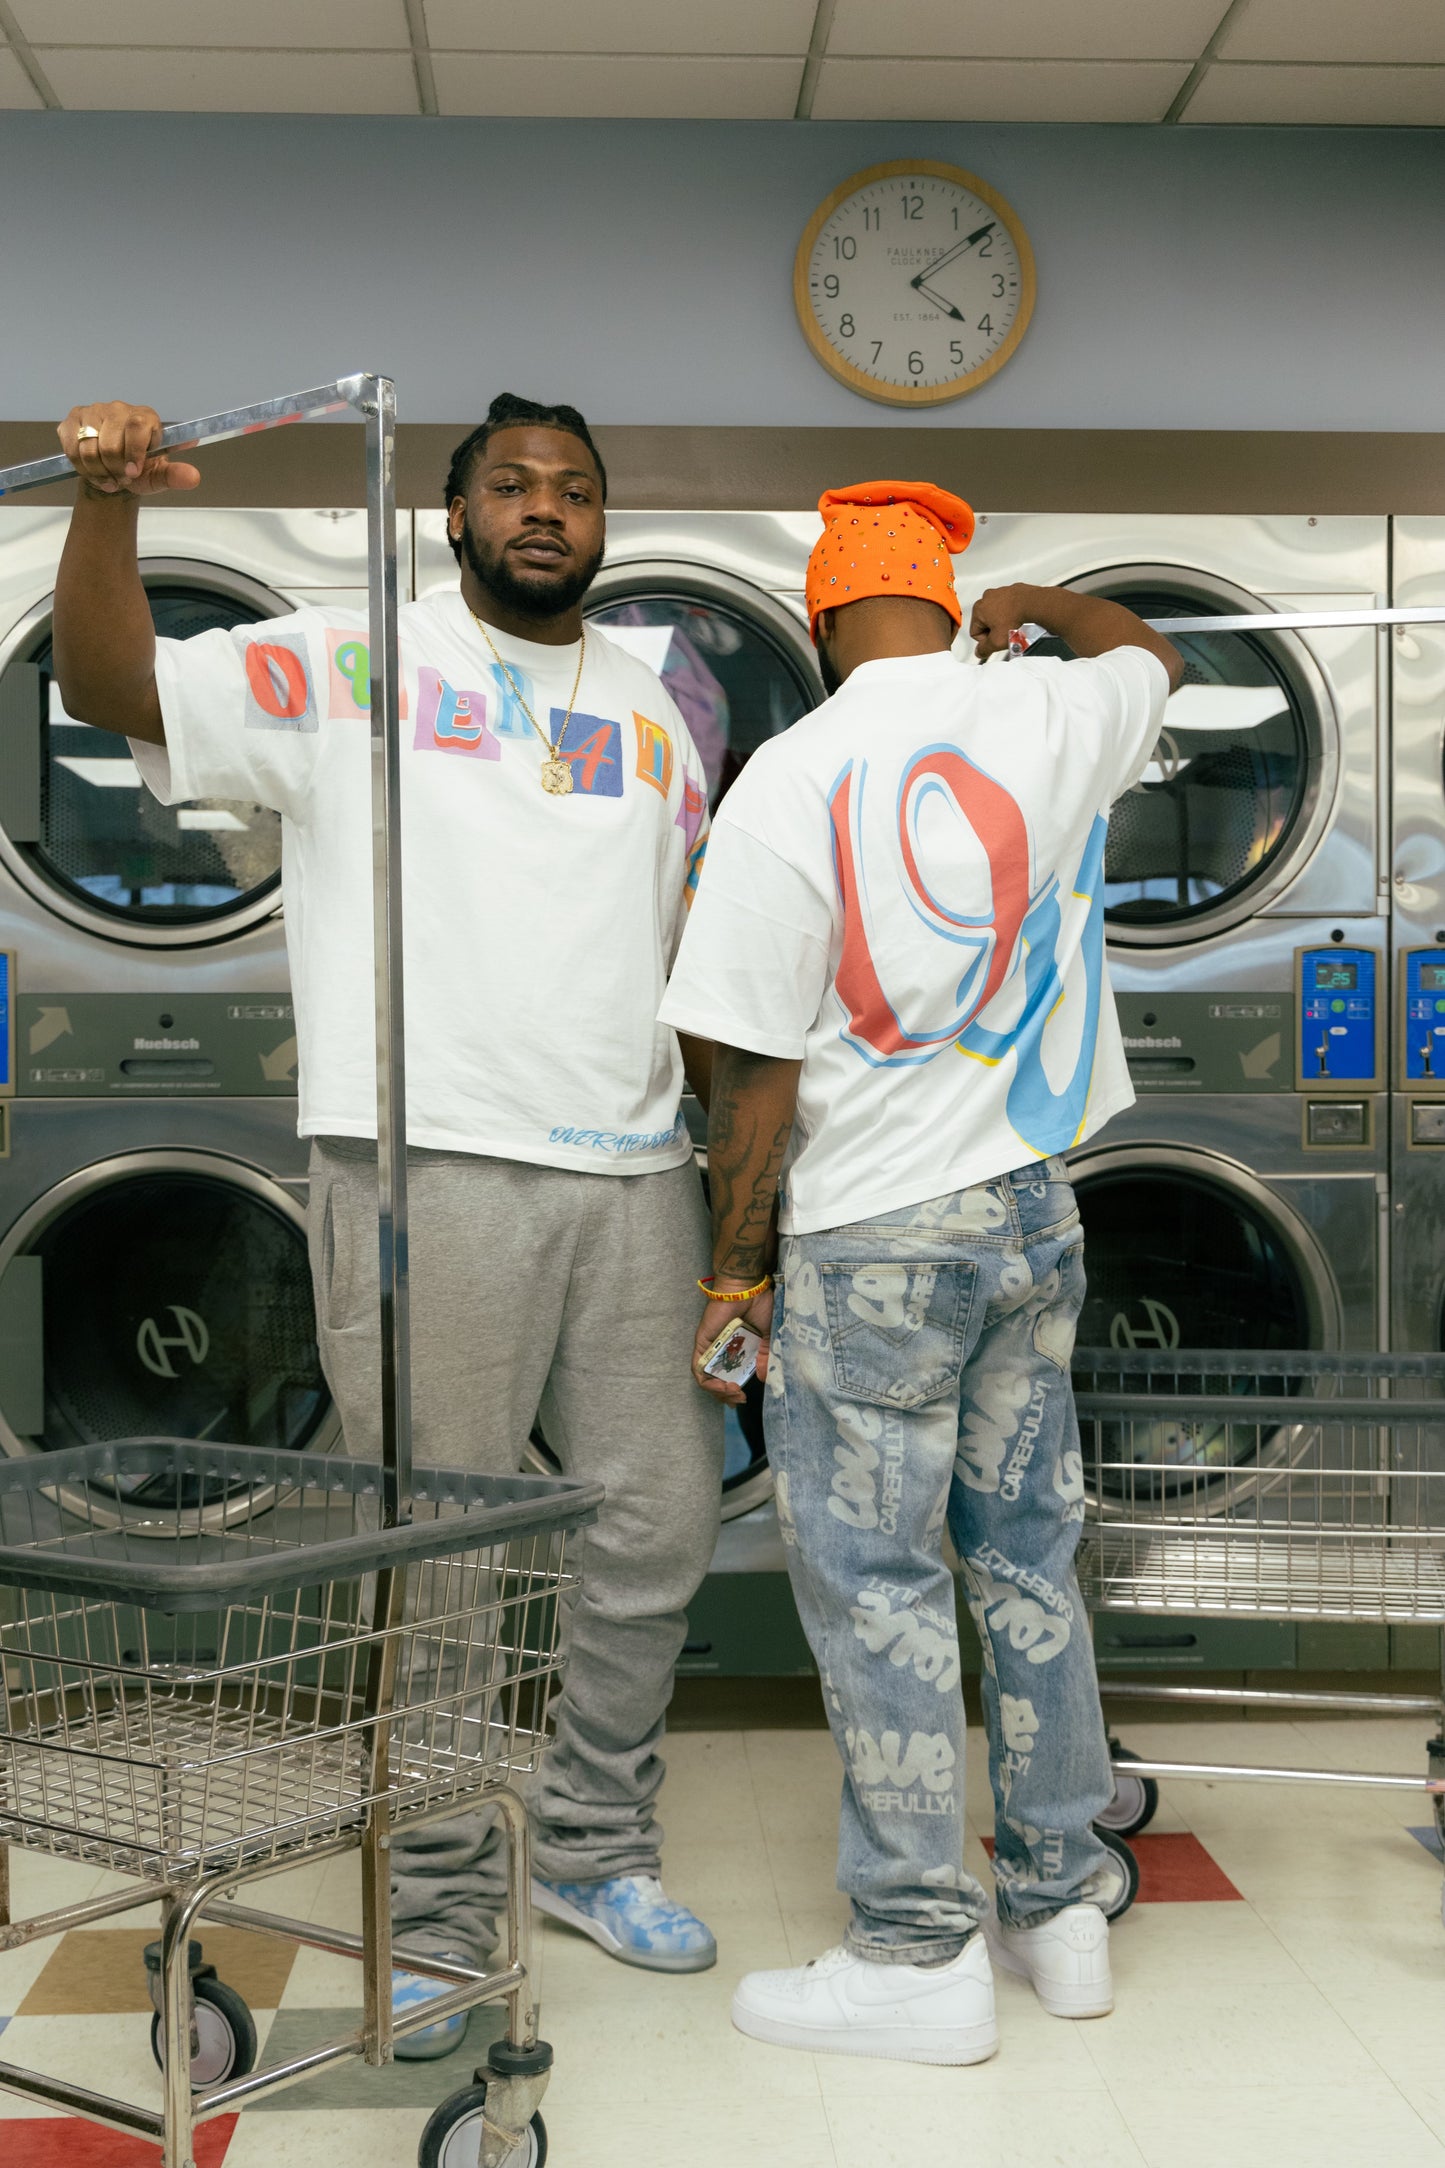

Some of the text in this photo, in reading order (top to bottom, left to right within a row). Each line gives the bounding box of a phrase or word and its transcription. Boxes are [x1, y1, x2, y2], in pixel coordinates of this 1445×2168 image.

[863, 207, 880, 231] 11
[901, 195, 925, 220] 12
[951, 207, 958, 231] 1
[833, 236, 857, 260] 10
[886, 247, 945, 257] FAULKNER
[978, 234, 993, 258] 2
[890, 257, 922, 266] CLOCK
[823, 274, 839, 299] 9
[991, 273, 1005, 298] 3
[839, 313, 855, 338] 8
[892, 313, 940, 322] EST. 1864
[977, 313, 994, 337] 4
[870, 341, 883, 365] 7
[908, 350, 924, 375] 6
[950, 340, 963, 365] 5
[134, 1037, 200, 1050] Huebsch
[1122, 1036, 1182, 1049] uebsch
